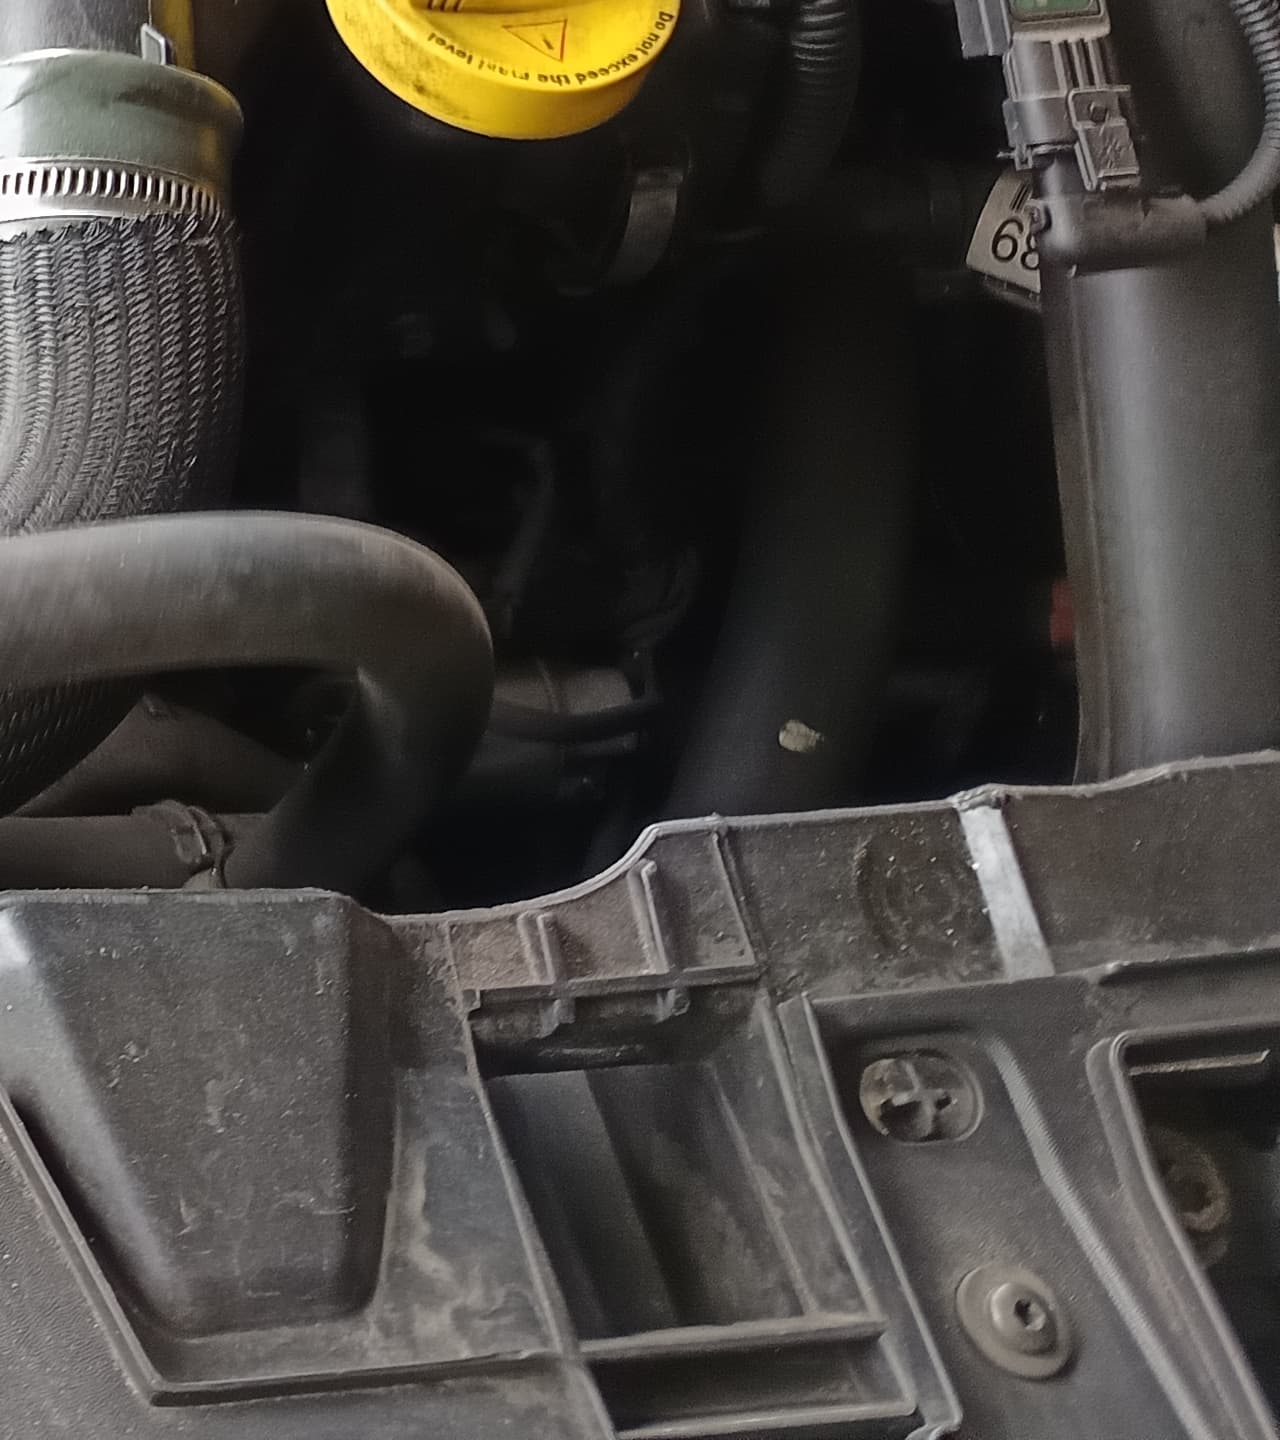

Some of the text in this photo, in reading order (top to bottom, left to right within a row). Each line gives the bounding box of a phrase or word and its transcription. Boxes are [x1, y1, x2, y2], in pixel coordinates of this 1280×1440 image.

[654, 10, 675, 31] Do
[427, 32, 474, 65] level
[639, 32, 661, 54] not
[537, 72, 572, 87] the
[575, 52, 640, 86] exceed
